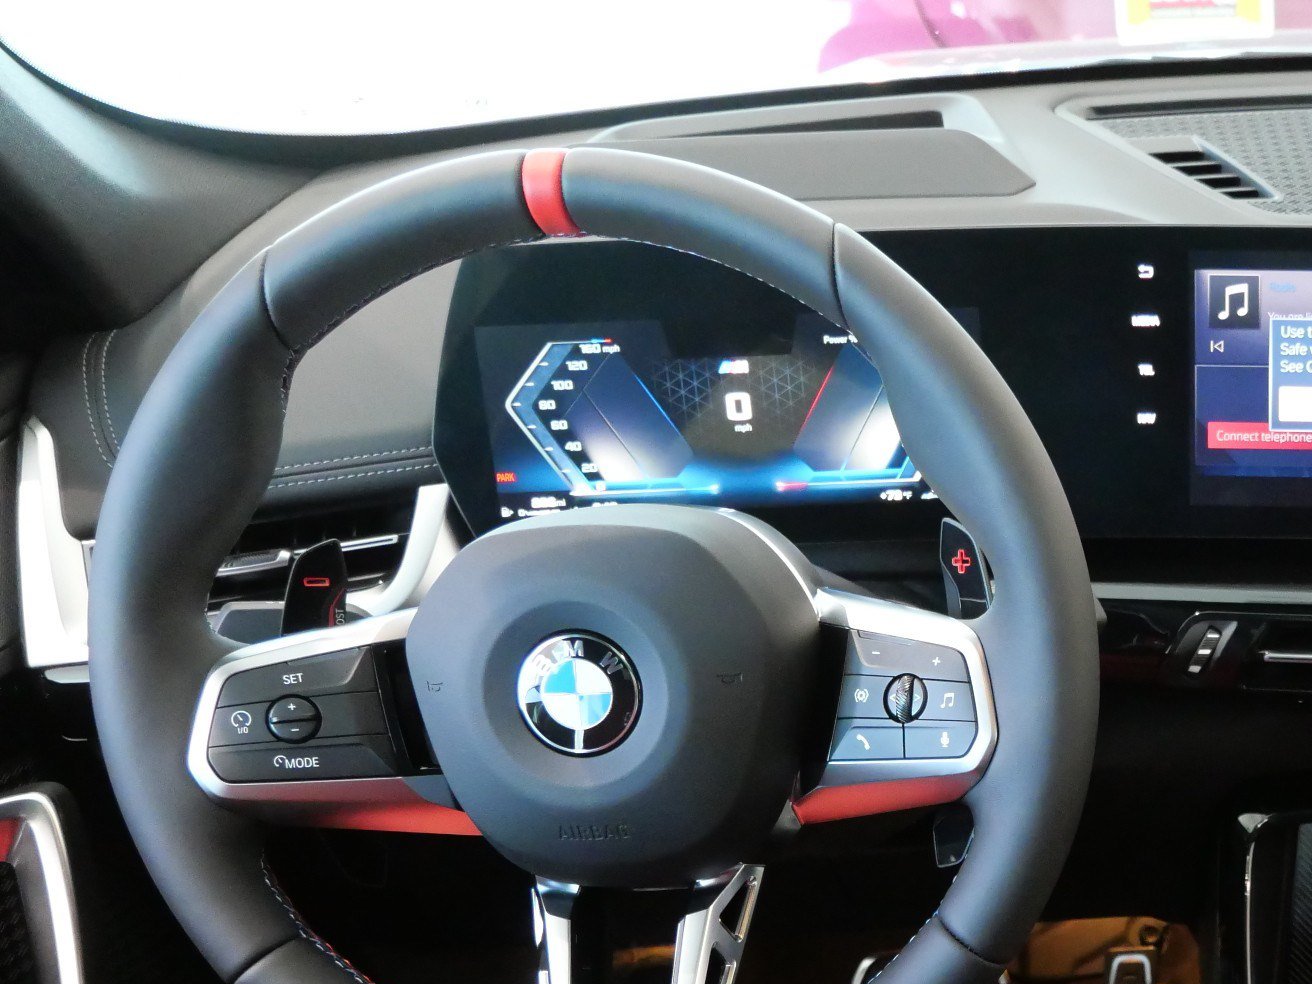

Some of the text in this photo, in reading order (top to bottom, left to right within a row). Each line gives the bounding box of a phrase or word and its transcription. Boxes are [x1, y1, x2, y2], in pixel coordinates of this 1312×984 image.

[1280, 325, 1305, 339] Use
[823, 335, 848, 344] Power
[602, 343, 621, 354] mph
[1280, 343, 1307, 356] Safe
[565, 360, 588, 371] 120
[1280, 360, 1303, 373] See
[551, 380, 574, 391] 100
[725, 391, 752, 421] 0
[734, 423, 753, 433] mph
[1216, 429, 1312, 444] Connect telephone
[565, 441, 582, 451] 40
[581, 463, 599, 473] 20
[496, 472, 516, 482] PARK
[531, 639, 623, 675] BMW
[282, 673, 303, 684] SET
[285, 757, 320, 769] MODE
